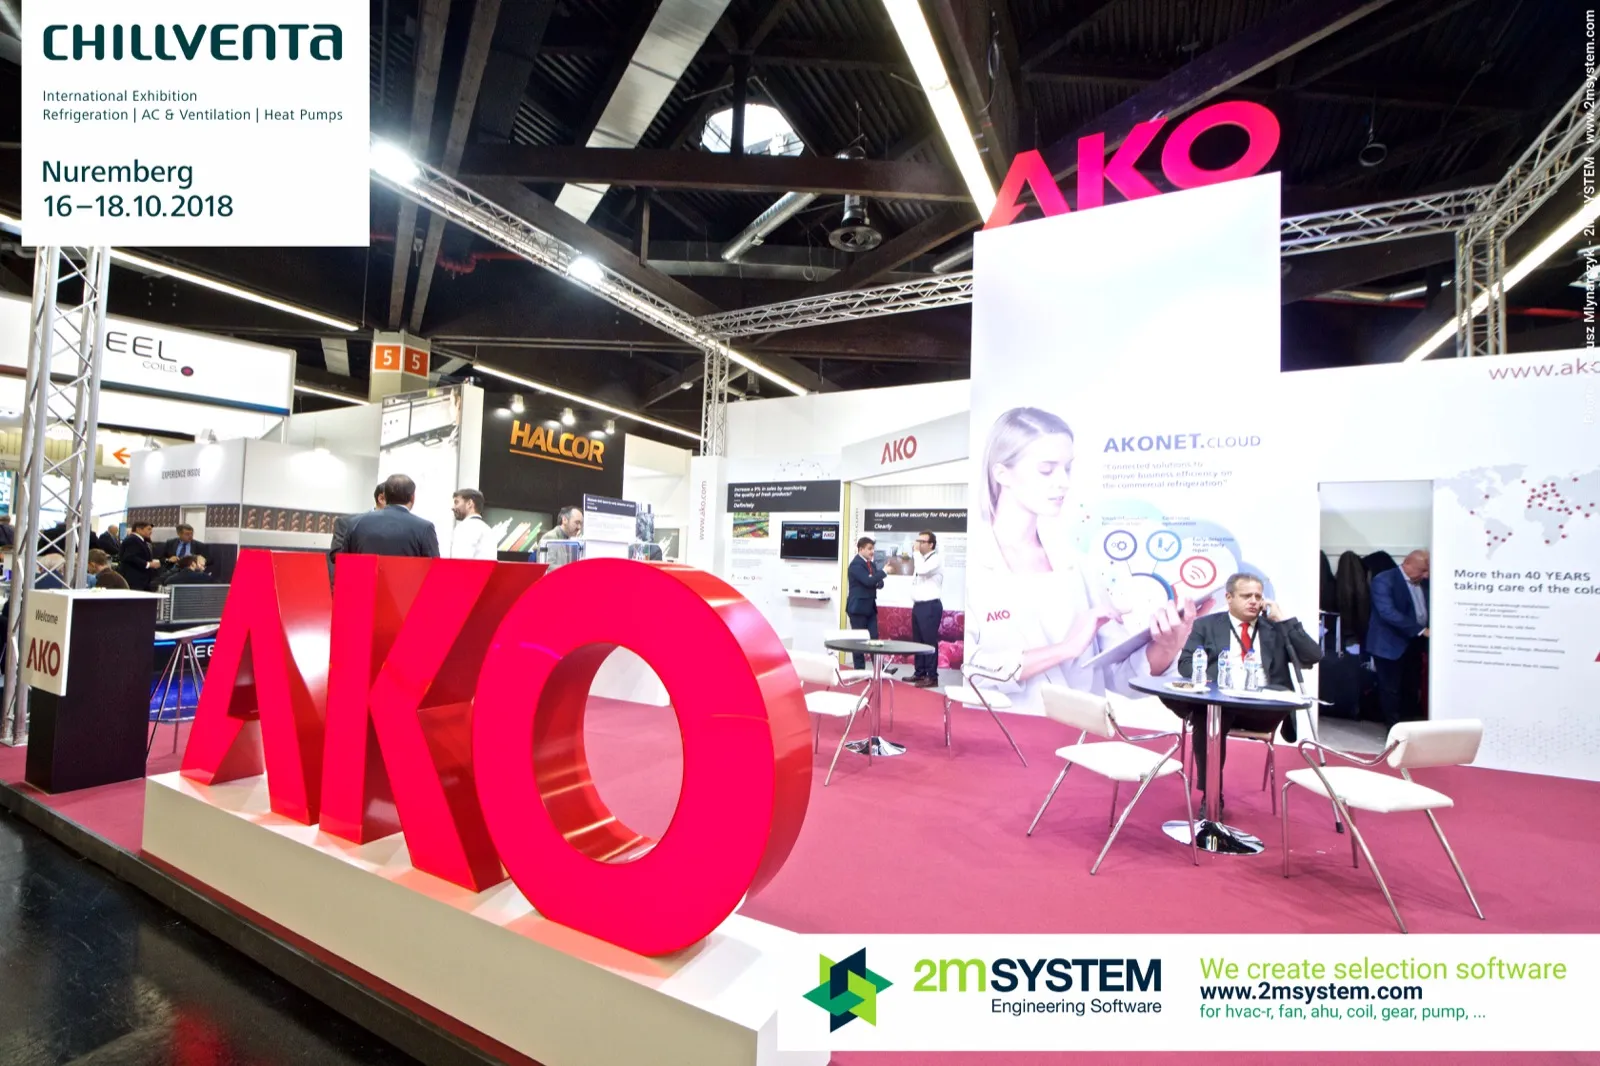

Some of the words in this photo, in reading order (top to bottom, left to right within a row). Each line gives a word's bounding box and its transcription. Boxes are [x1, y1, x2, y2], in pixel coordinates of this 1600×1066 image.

[982, 100, 1281, 232] AKO
[383, 349, 392, 366] 5
[412, 353, 420, 370] 5
[510, 420, 605, 465] HALCOR
[880, 435, 918, 465] AKO
[1454, 569, 1487, 579] More
[1491, 570, 1521, 580] than
[1524, 571, 1541, 580] 40
[1545, 572, 1591, 582] YEARS
[1454, 582, 1494, 593] taking
[1498, 583, 1525, 592] care
[1529, 584, 1543, 593] of
[1548, 584, 1570, 594] the
[35, 609, 59, 625] Welcome
[986, 609, 1011, 623] AKO
[26, 637, 61, 677] AKO
[180, 549, 811, 957] AKO
